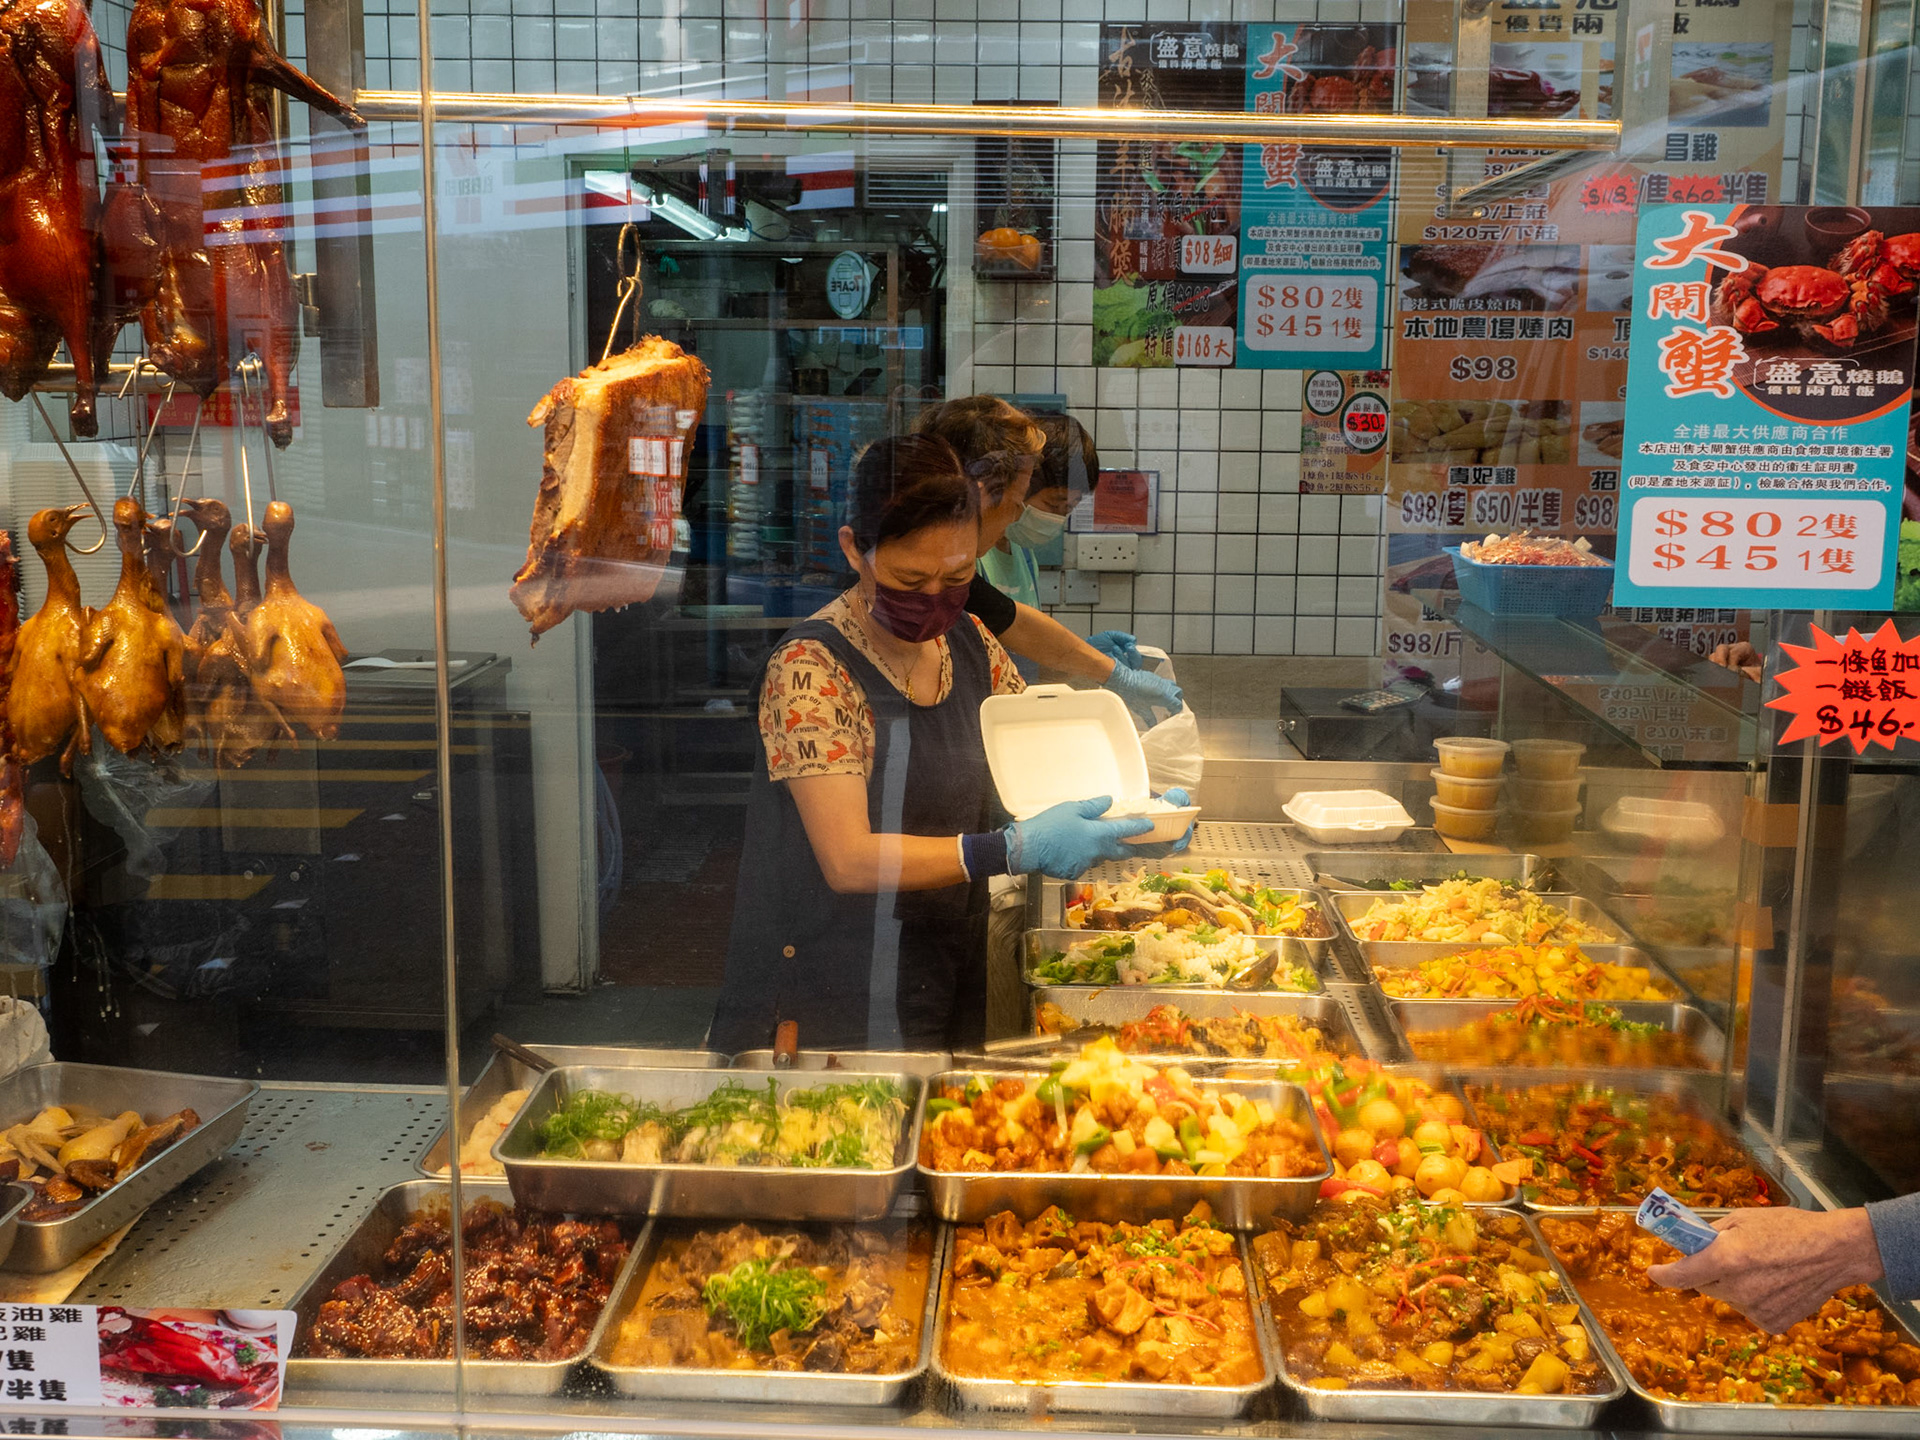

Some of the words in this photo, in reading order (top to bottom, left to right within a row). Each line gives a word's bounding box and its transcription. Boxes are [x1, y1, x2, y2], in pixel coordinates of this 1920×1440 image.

[1267, 212, 1359, 225] 全港最大供應商合作
[1257, 284, 1325, 309] $80
[1331, 286, 1363, 310] 2隻
[1643, 210, 1750, 400] 大閘蟹
[1256, 313, 1323, 338] $45
[1331, 316, 1363, 339] 1隻
[1404, 317, 1573, 339] 本地農場燒肉
[1451, 355, 1517, 380] $98
[1765, 361, 1905, 385] 盛意燒鵝
[1673, 424, 1848, 440] 全港最大供應商合作
[1449, 467, 1517, 484] 貴妃雞
[1402, 490, 1467, 528] $98/隻
[1476, 491, 1562, 528] $50/半隻
[1655, 508, 1782, 538] $80
[1797, 512, 1859, 540] 2隻
[1652, 542, 1778, 572] $45
[1797, 547, 1857, 575] 1隻
[792, 671, 812, 691] M
[797, 740, 819, 760] M
[0, 1306, 83, 1323] 油雞
